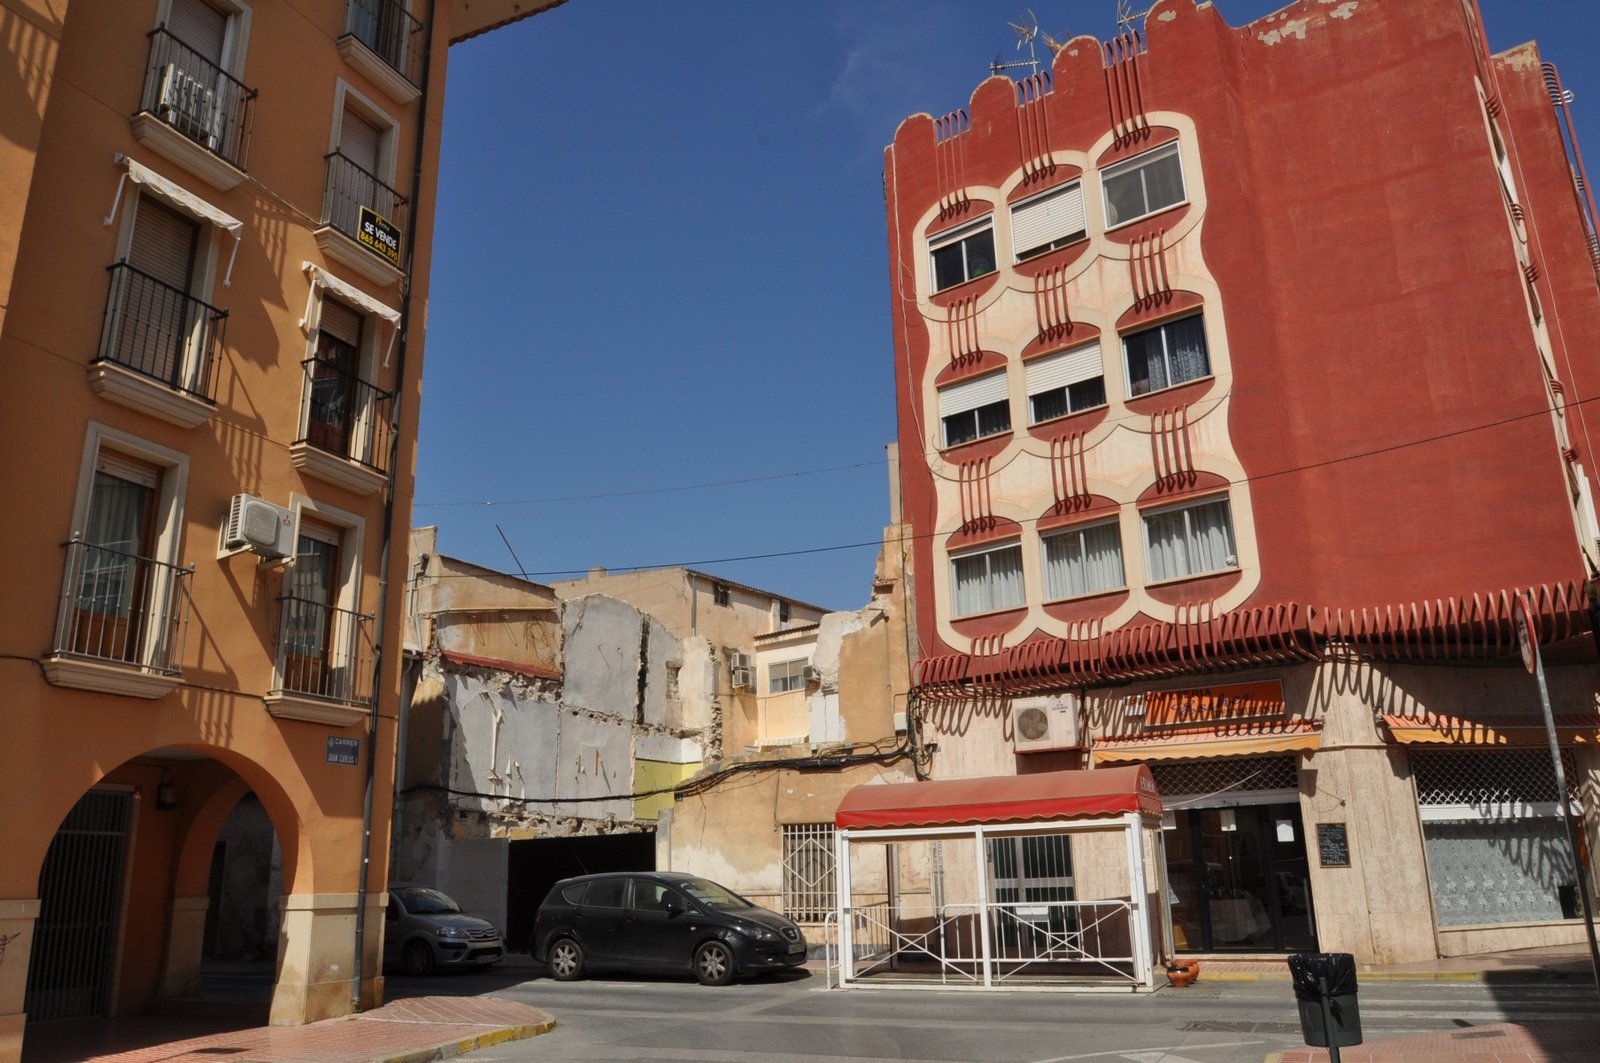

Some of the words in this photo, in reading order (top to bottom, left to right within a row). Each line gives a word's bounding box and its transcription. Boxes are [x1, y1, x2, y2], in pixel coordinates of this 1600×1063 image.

[364, 222, 375, 235] SE
[375, 227, 398, 250] VENDE
[339, 754, 354, 764] CARLOS
